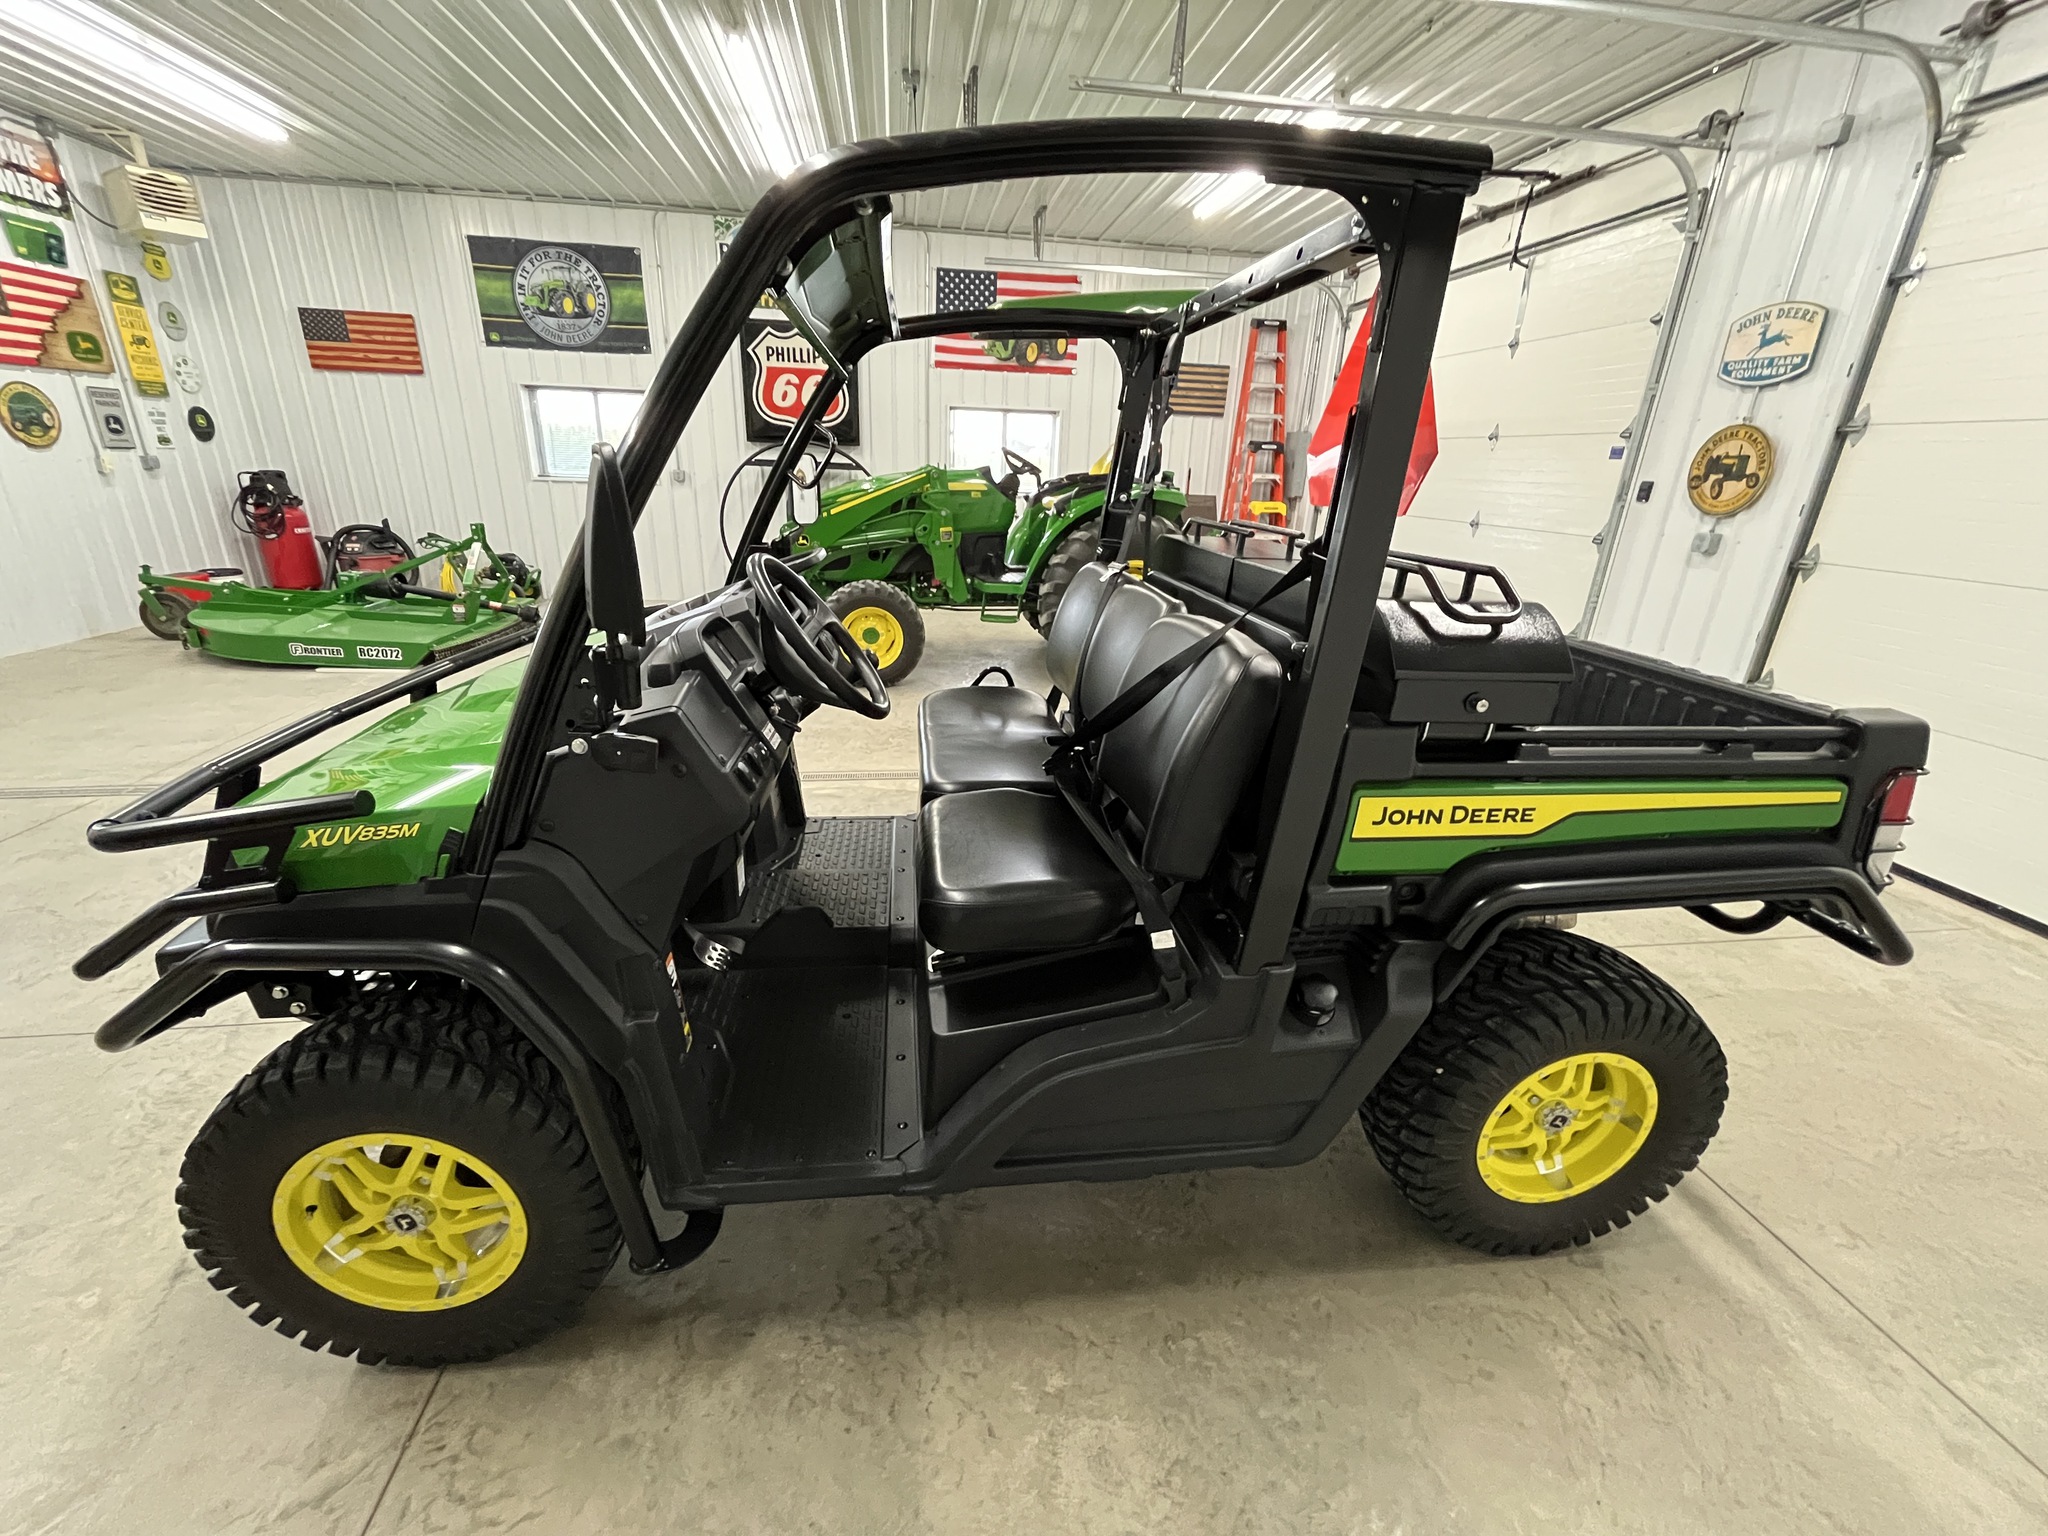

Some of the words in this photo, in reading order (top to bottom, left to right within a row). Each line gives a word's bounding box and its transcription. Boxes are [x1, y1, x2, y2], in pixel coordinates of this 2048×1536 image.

[0, 136, 42, 171] THE
[528, 250, 552, 268] FOR
[555, 250, 582, 268] THE
[519, 266, 530, 280] IT
[517, 282, 526, 296] IN
[584, 266, 606, 327] TRACTOR
[1736, 309, 1773, 333] JOHN
[1776, 307, 1819, 323] DEERE
[540, 326, 563, 342] JOHN
[566, 329, 594, 343] DEERE
[766, 345, 826, 364] PHILLIP
[1727, 358, 1770, 371] QUALITY
[1773, 355, 1802, 366] FARM
[1731, 365, 1793, 379] EQUIPMENT
[1695, 447, 1711, 472] JOHN
[1712, 430, 1740, 447] DEERE
[1743, 430, 1767, 472] TRACTORS
[290, 643, 343, 656] FRONTIER
[358, 647, 401, 659] RC2072
[1372, 806, 1444, 825] JOHN
[1449, 805, 1536, 824] DEERE
[300, 823, 420, 848] XUV835M
